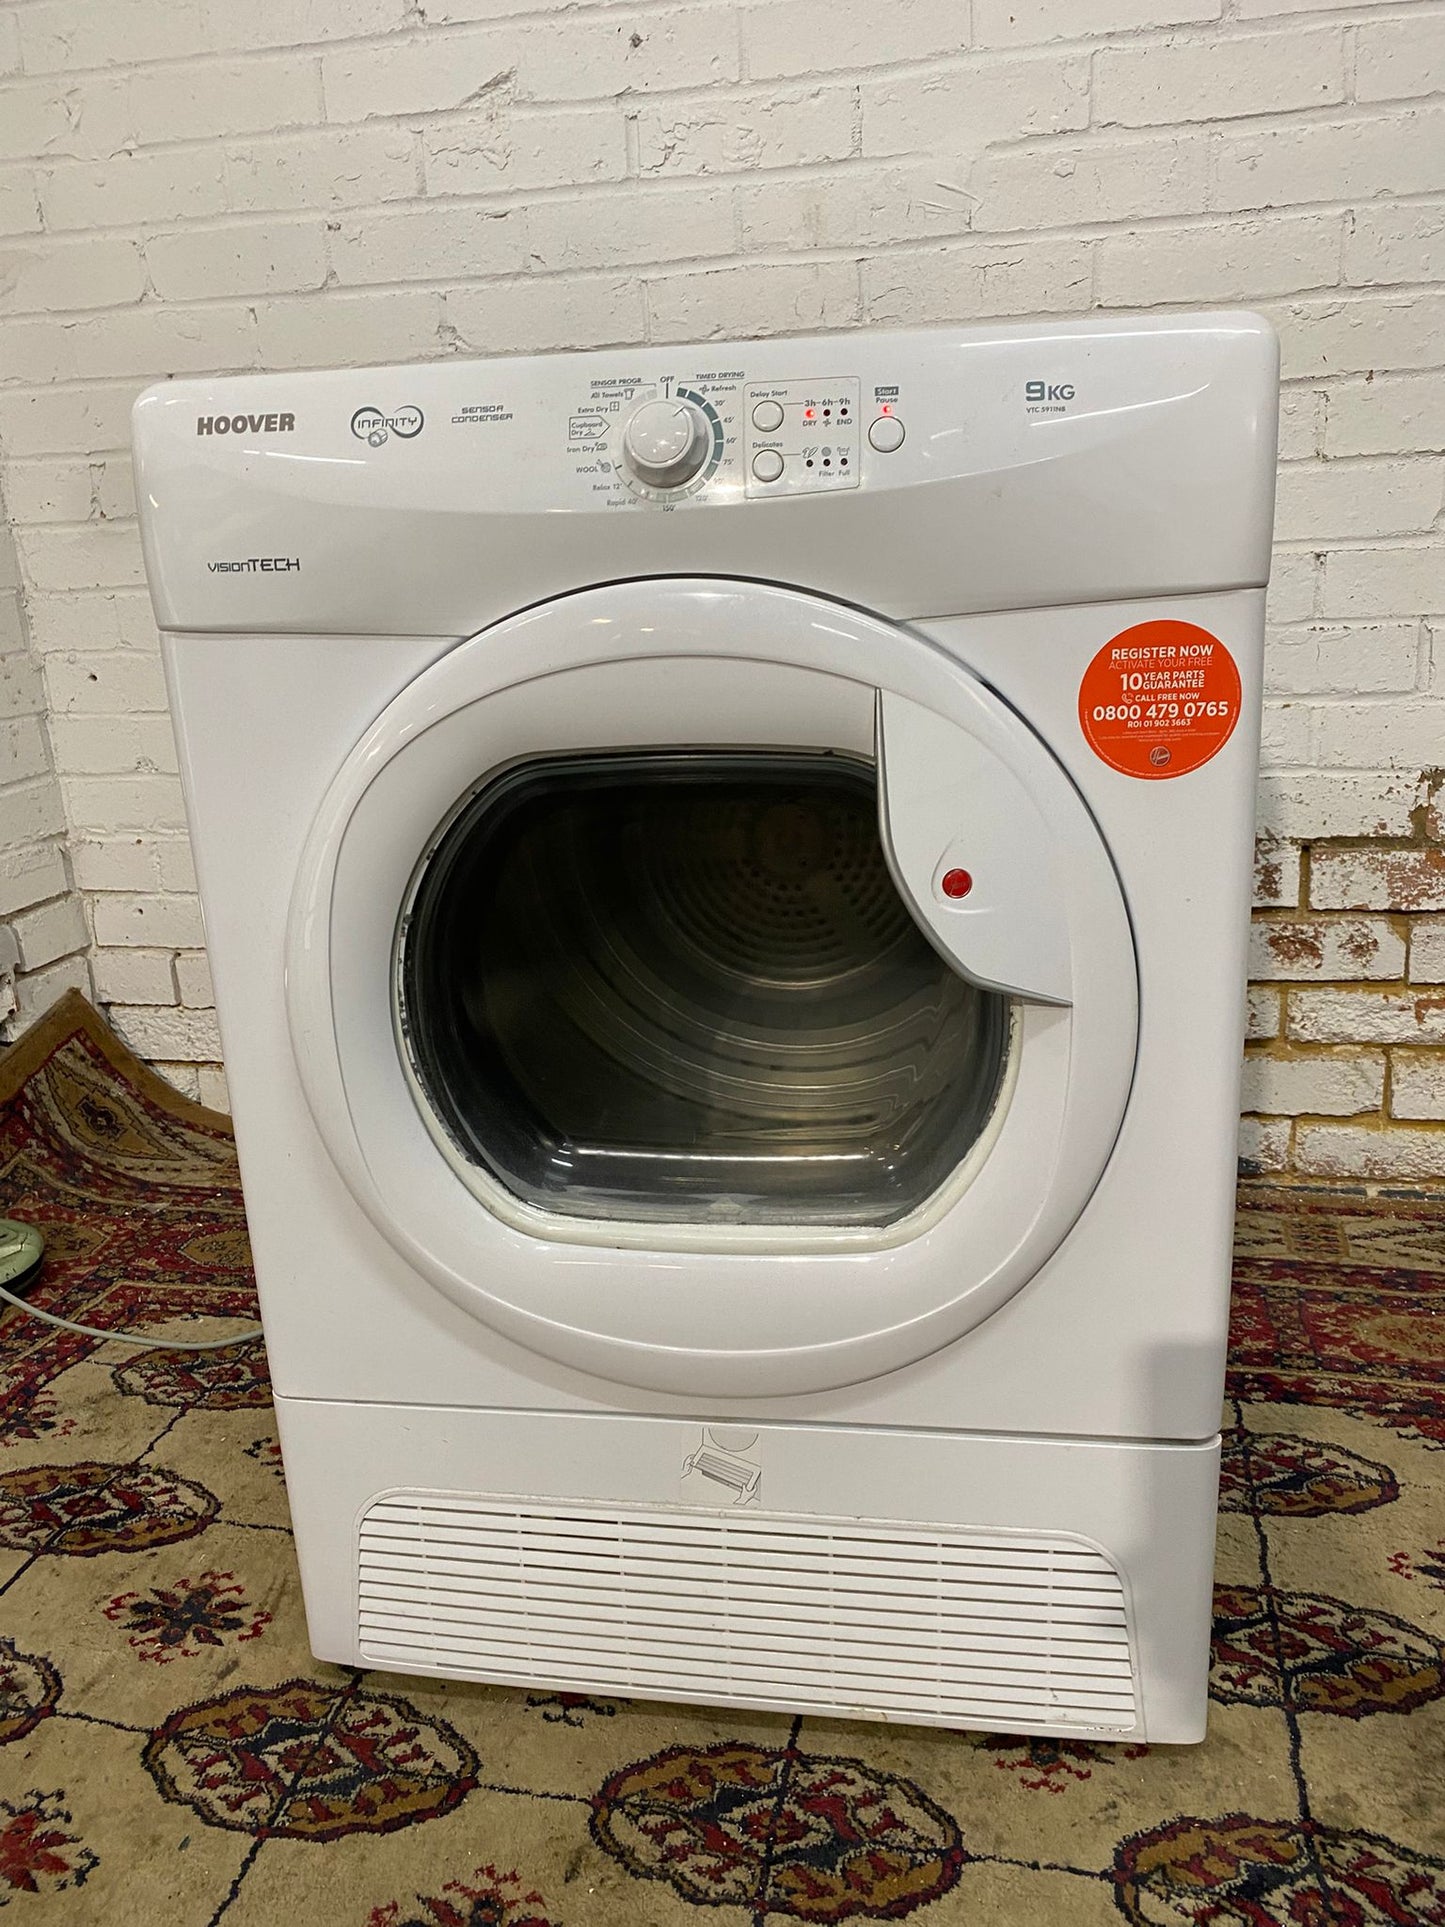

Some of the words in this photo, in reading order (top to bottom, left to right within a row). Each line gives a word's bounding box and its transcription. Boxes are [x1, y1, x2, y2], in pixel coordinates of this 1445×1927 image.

[197, 412, 295, 436] HOOVER
[358, 417, 418, 429] INFINITY
[451, 413, 513, 423] CONDENSER
[571, 421, 603, 429] Cupboard
[583, 445, 595, 453] Dry
[207, 557, 300, 573] visionTECH
[1112, 646, 1176, 660] REGISTER
[1180, 645, 1214, 657] NOW
[1109, 659, 1155, 670] ACTIVATE
[1158, 658, 1186, 668] YOUR
[1188, 657, 1213, 666] FREE
[1120, 673, 1143, 691] 10
[1143, 671, 1171, 681] YEAR
[1173, 670, 1205, 679] PARTS
[1143, 679, 1204, 690] GUARANTEE
[1135, 694, 1155, 702] CALL
[1158, 693, 1177, 701] FREE
[1179, 692, 1200, 700] NOW
[1093, 705, 1141, 721] 0800
[1146, 703, 1178, 719] 479
[1184, 701, 1228, 717] 0765
[1154, 719, 1169, 727] 902
